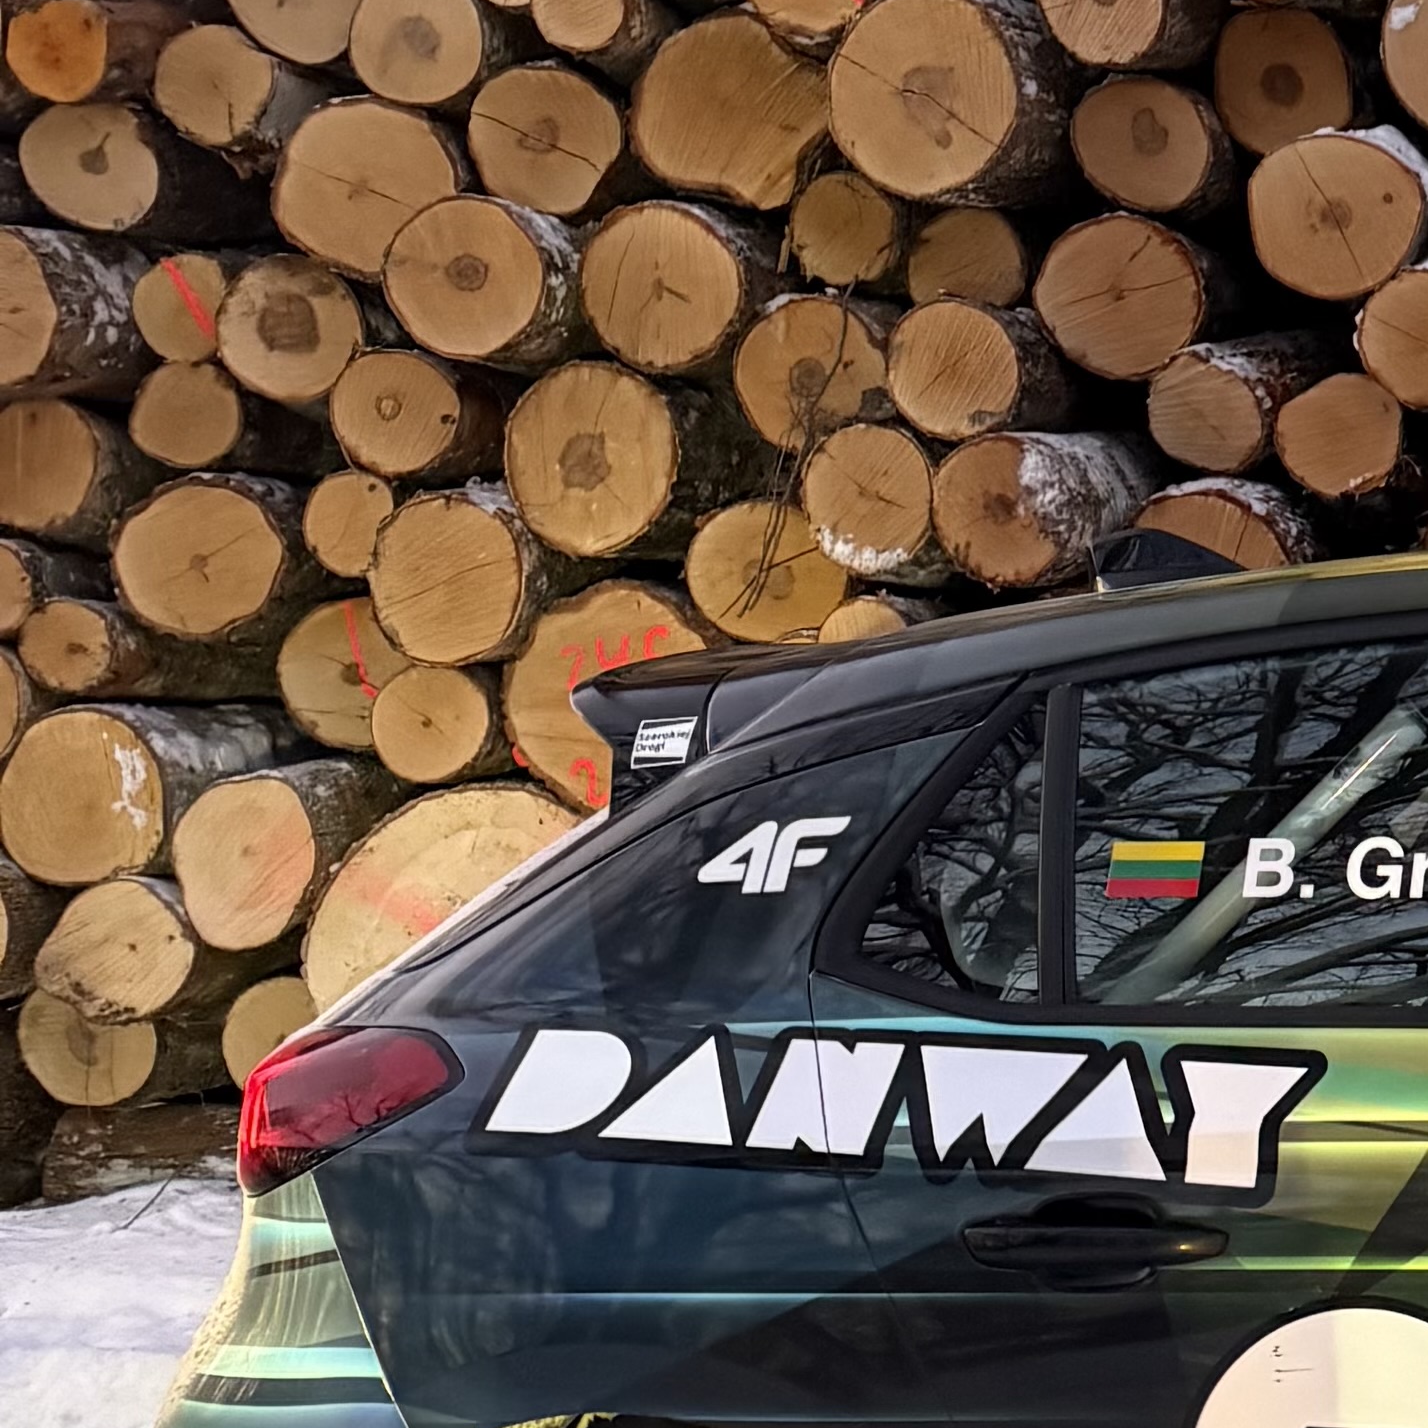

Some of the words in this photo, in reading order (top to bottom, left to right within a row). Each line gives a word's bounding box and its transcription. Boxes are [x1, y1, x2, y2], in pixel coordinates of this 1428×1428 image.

[697, 815, 852, 894] 4F
[1242, 837, 1315, 899] B.
[484, 1028, 1310, 1189] DANWAY
